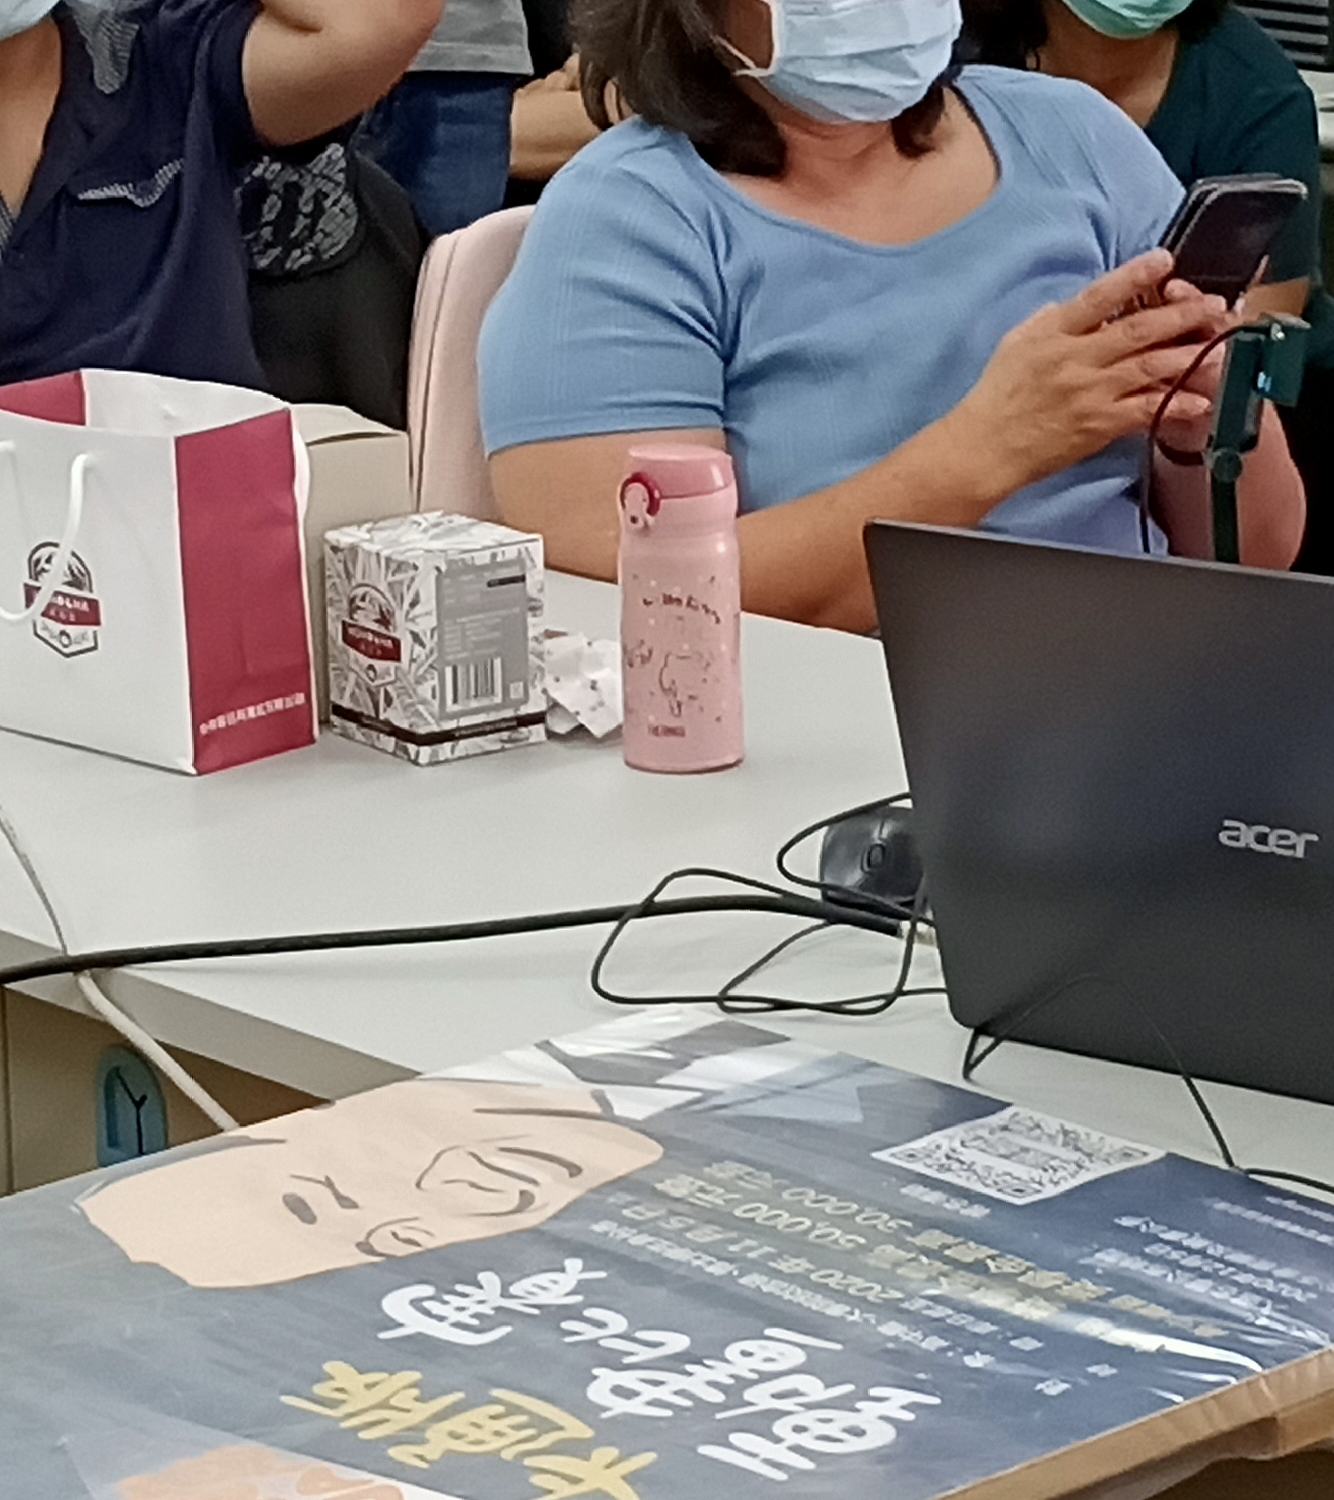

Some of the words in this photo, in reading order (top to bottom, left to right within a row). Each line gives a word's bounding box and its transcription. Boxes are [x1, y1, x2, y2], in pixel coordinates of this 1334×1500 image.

[1218, 819, 1319, 858] acer
[279, 1361, 659, 1500] 卡通版
